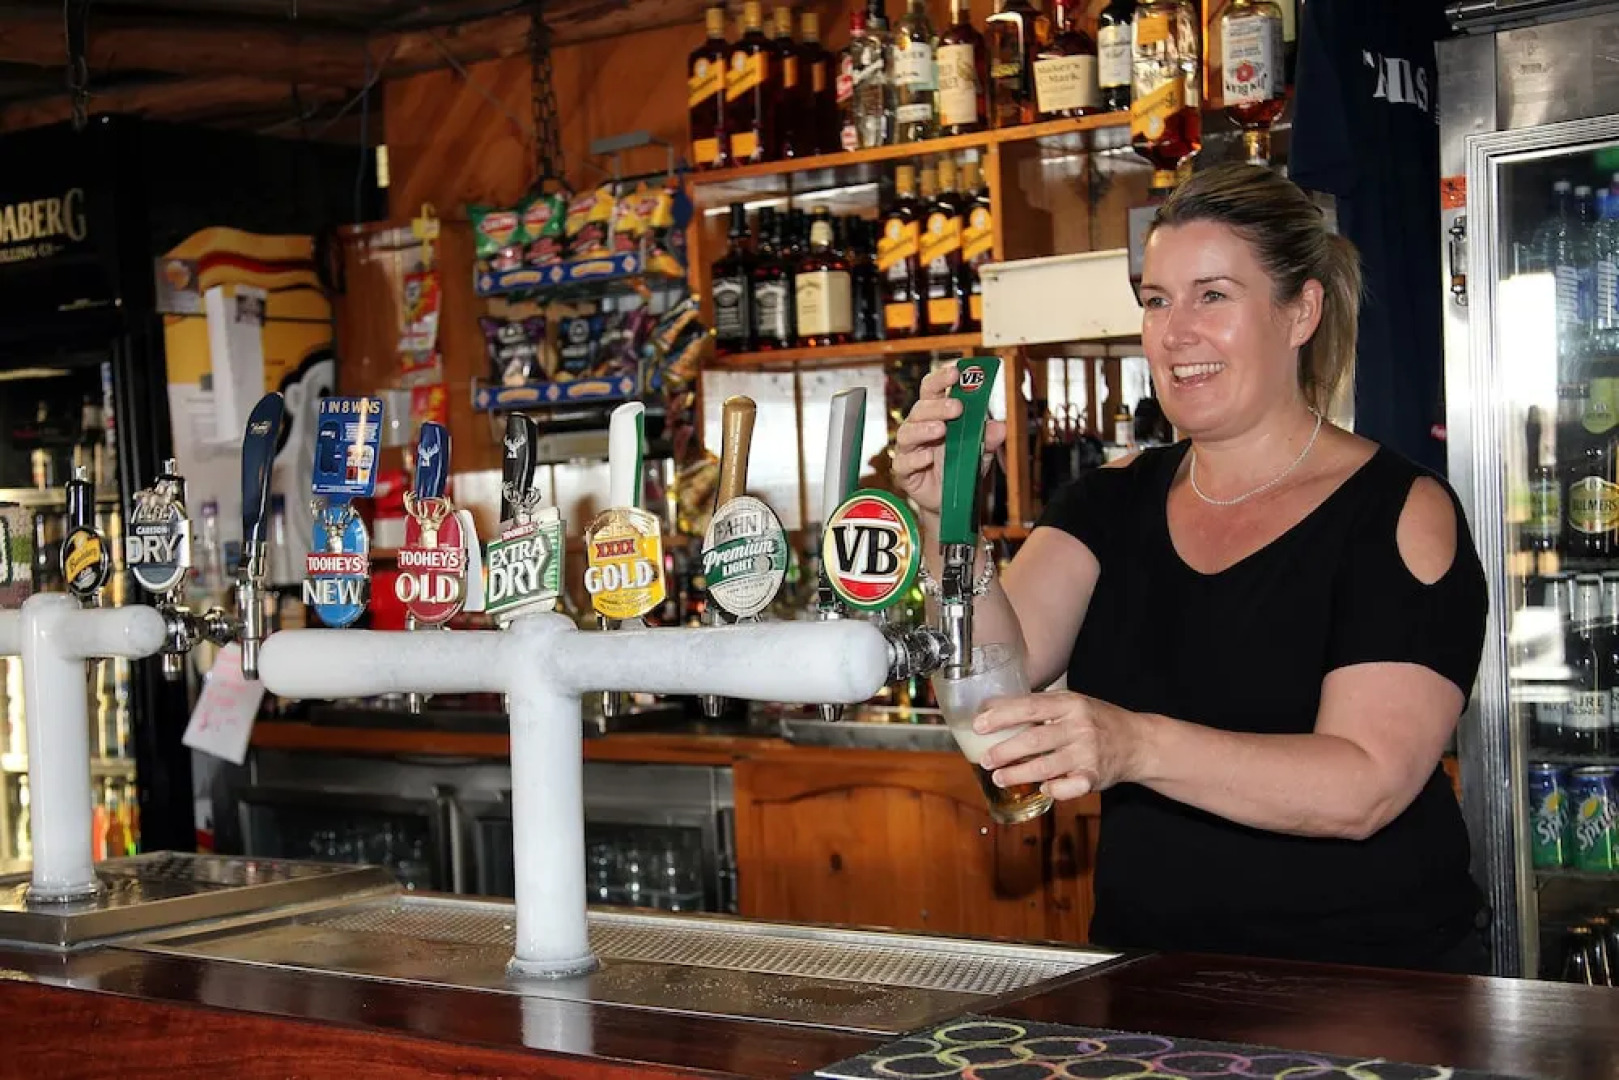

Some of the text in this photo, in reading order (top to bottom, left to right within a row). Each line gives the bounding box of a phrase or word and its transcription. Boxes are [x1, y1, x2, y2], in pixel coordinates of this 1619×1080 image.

[0, 187, 86, 243] ABERG
[321, 401, 326, 413] 1
[328, 401, 340, 413] IN
[341, 401, 350, 413] 8
[126, 535, 177, 563] DRY
[308, 556, 362, 571] TOOHEYS
[400, 551, 459, 567] TOOHEYS
[490, 535, 547, 569] EXTRA
[595, 539, 635, 558] XXXX
[702, 537, 776, 575] Premium
[832, 526, 898, 574] VB
[489, 554, 546, 603] DRY
[584, 560, 655, 594] GOLD
[723, 557, 754, 576] LIGHT
[302, 578, 361, 605] NEW
[395, 572, 459, 604] OLD
